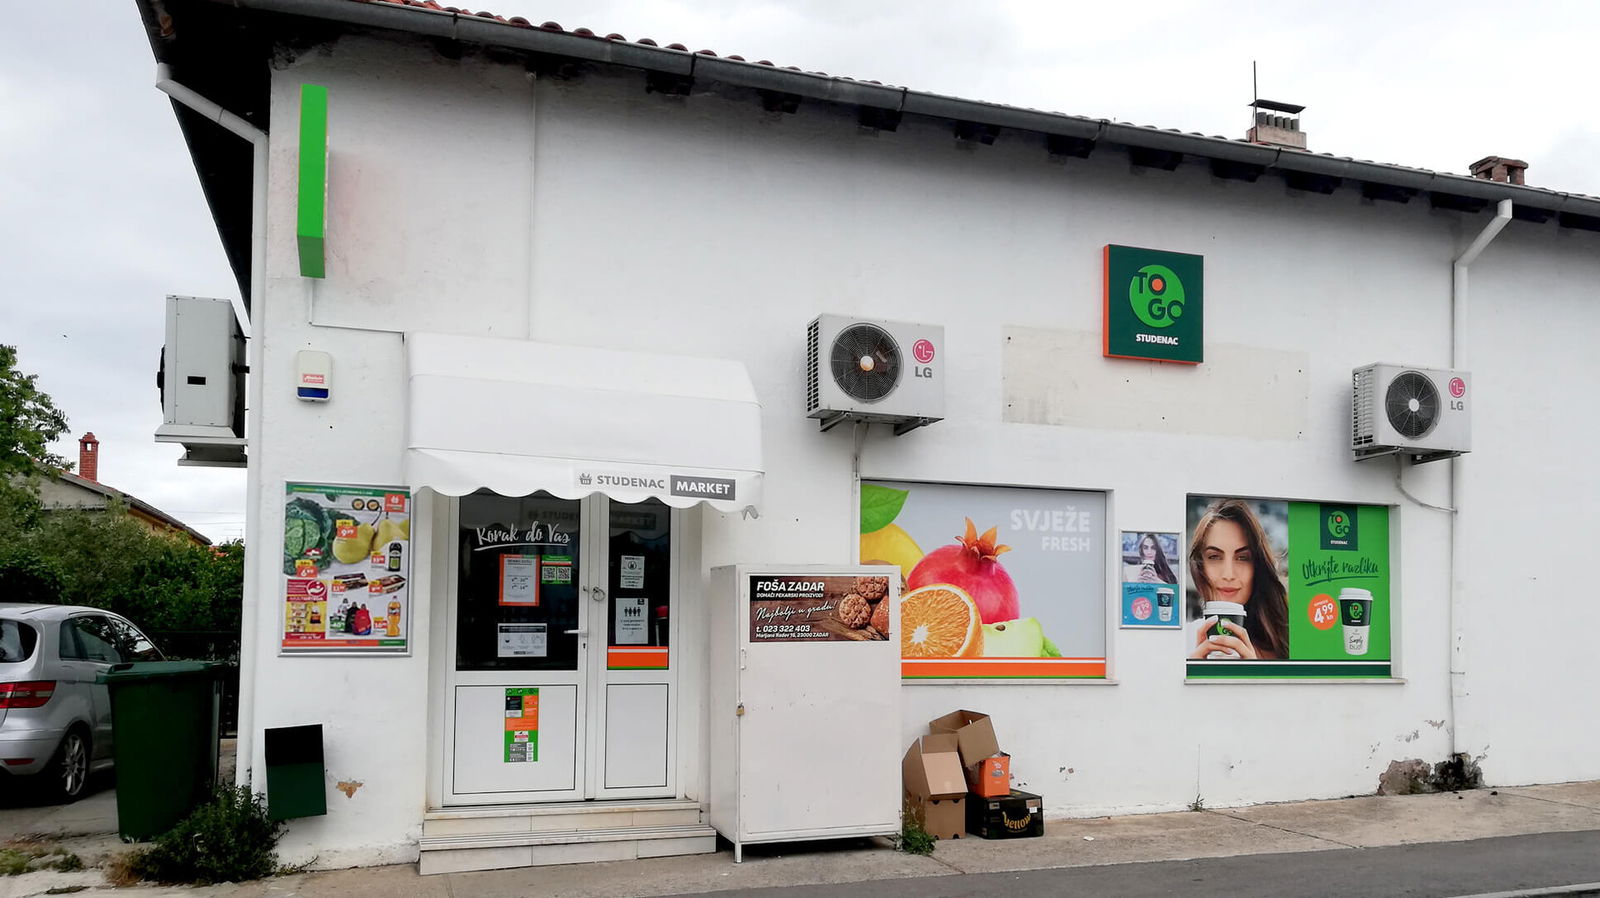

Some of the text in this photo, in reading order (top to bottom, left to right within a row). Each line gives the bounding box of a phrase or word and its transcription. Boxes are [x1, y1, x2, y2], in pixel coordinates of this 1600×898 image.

[1135, 271, 1167, 296] TO
[1147, 298, 1186, 321] GO
[1135, 333, 1179, 346] STUDENAC
[914, 365, 933, 379] LG
[1450, 400, 1464, 411] LG
[596, 475, 731, 496] STUDENAC MARKET
[1009, 505, 1091, 533] SVJEŽE
[476, 520, 571, 546] Korak do Vas
[1041, 535, 1091, 552] FRESH
[1342, 557, 1379, 574] razliku
[756, 578, 825, 592] FOŠA ZADAR
[763, 625, 778, 633] 023
[779, 625, 794, 633] 322
[795, 624, 811, 632] 403
